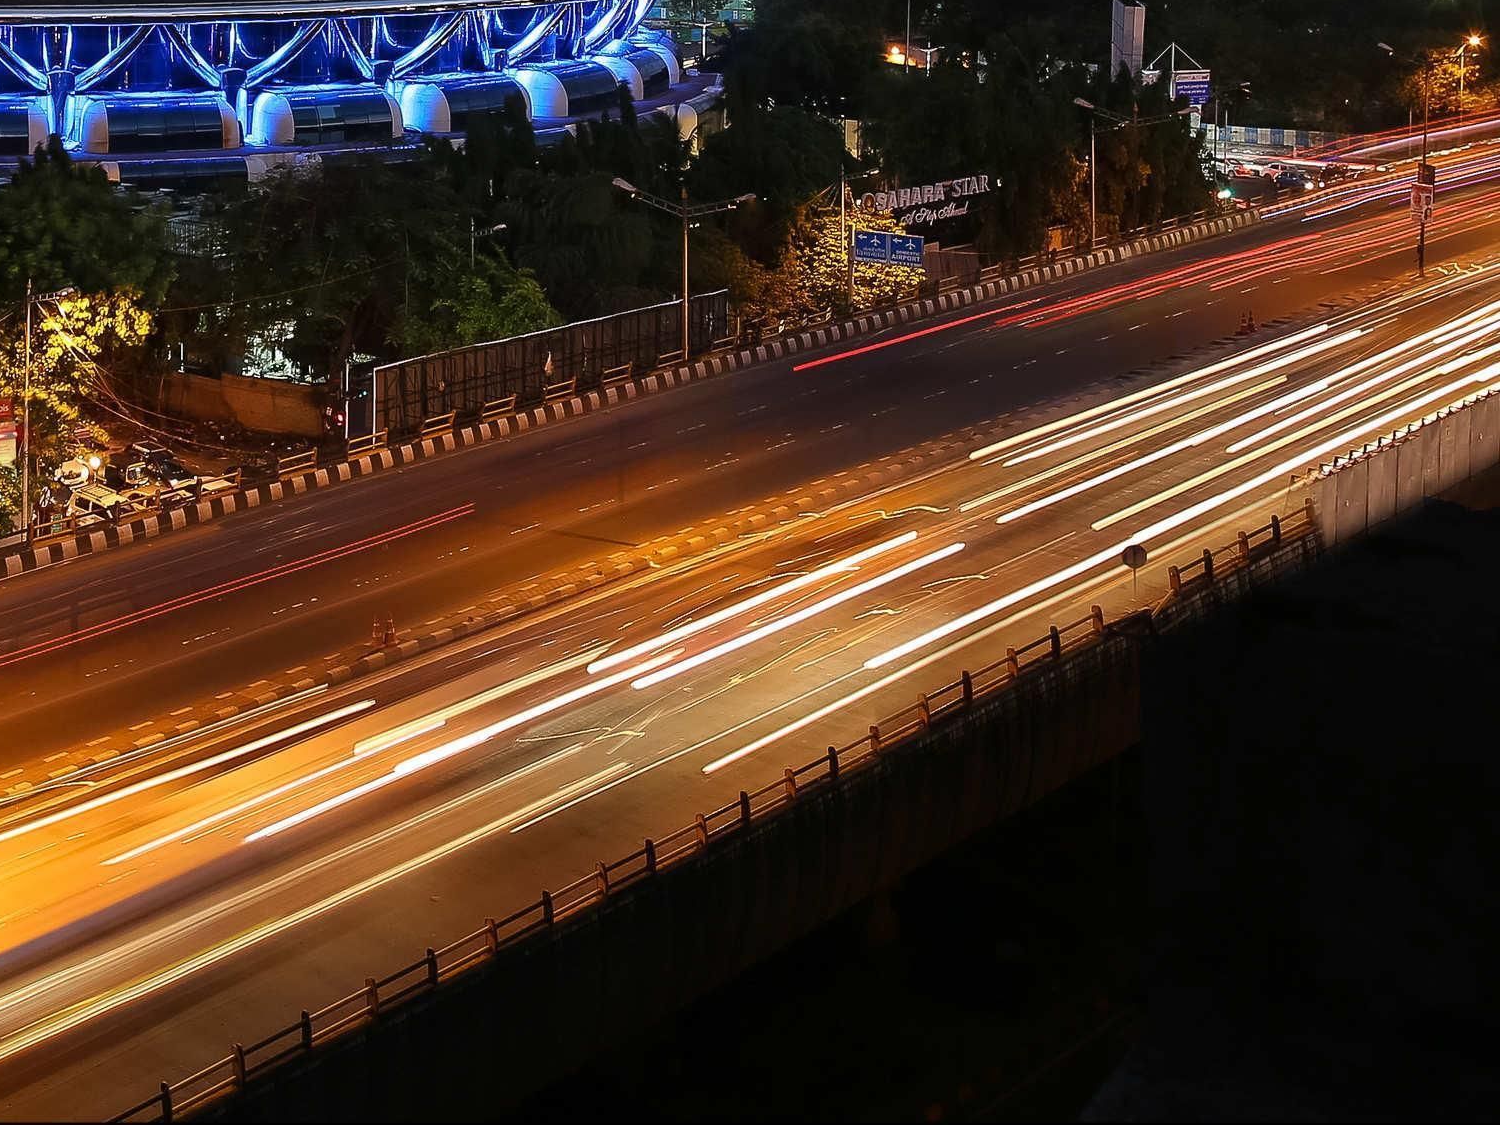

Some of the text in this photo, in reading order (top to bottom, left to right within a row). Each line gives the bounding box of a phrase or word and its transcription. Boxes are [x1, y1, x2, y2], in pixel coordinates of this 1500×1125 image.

[875, 175, 990, 211] SAHARA STAR
[891, 254, 920, 262] AIRPORT
